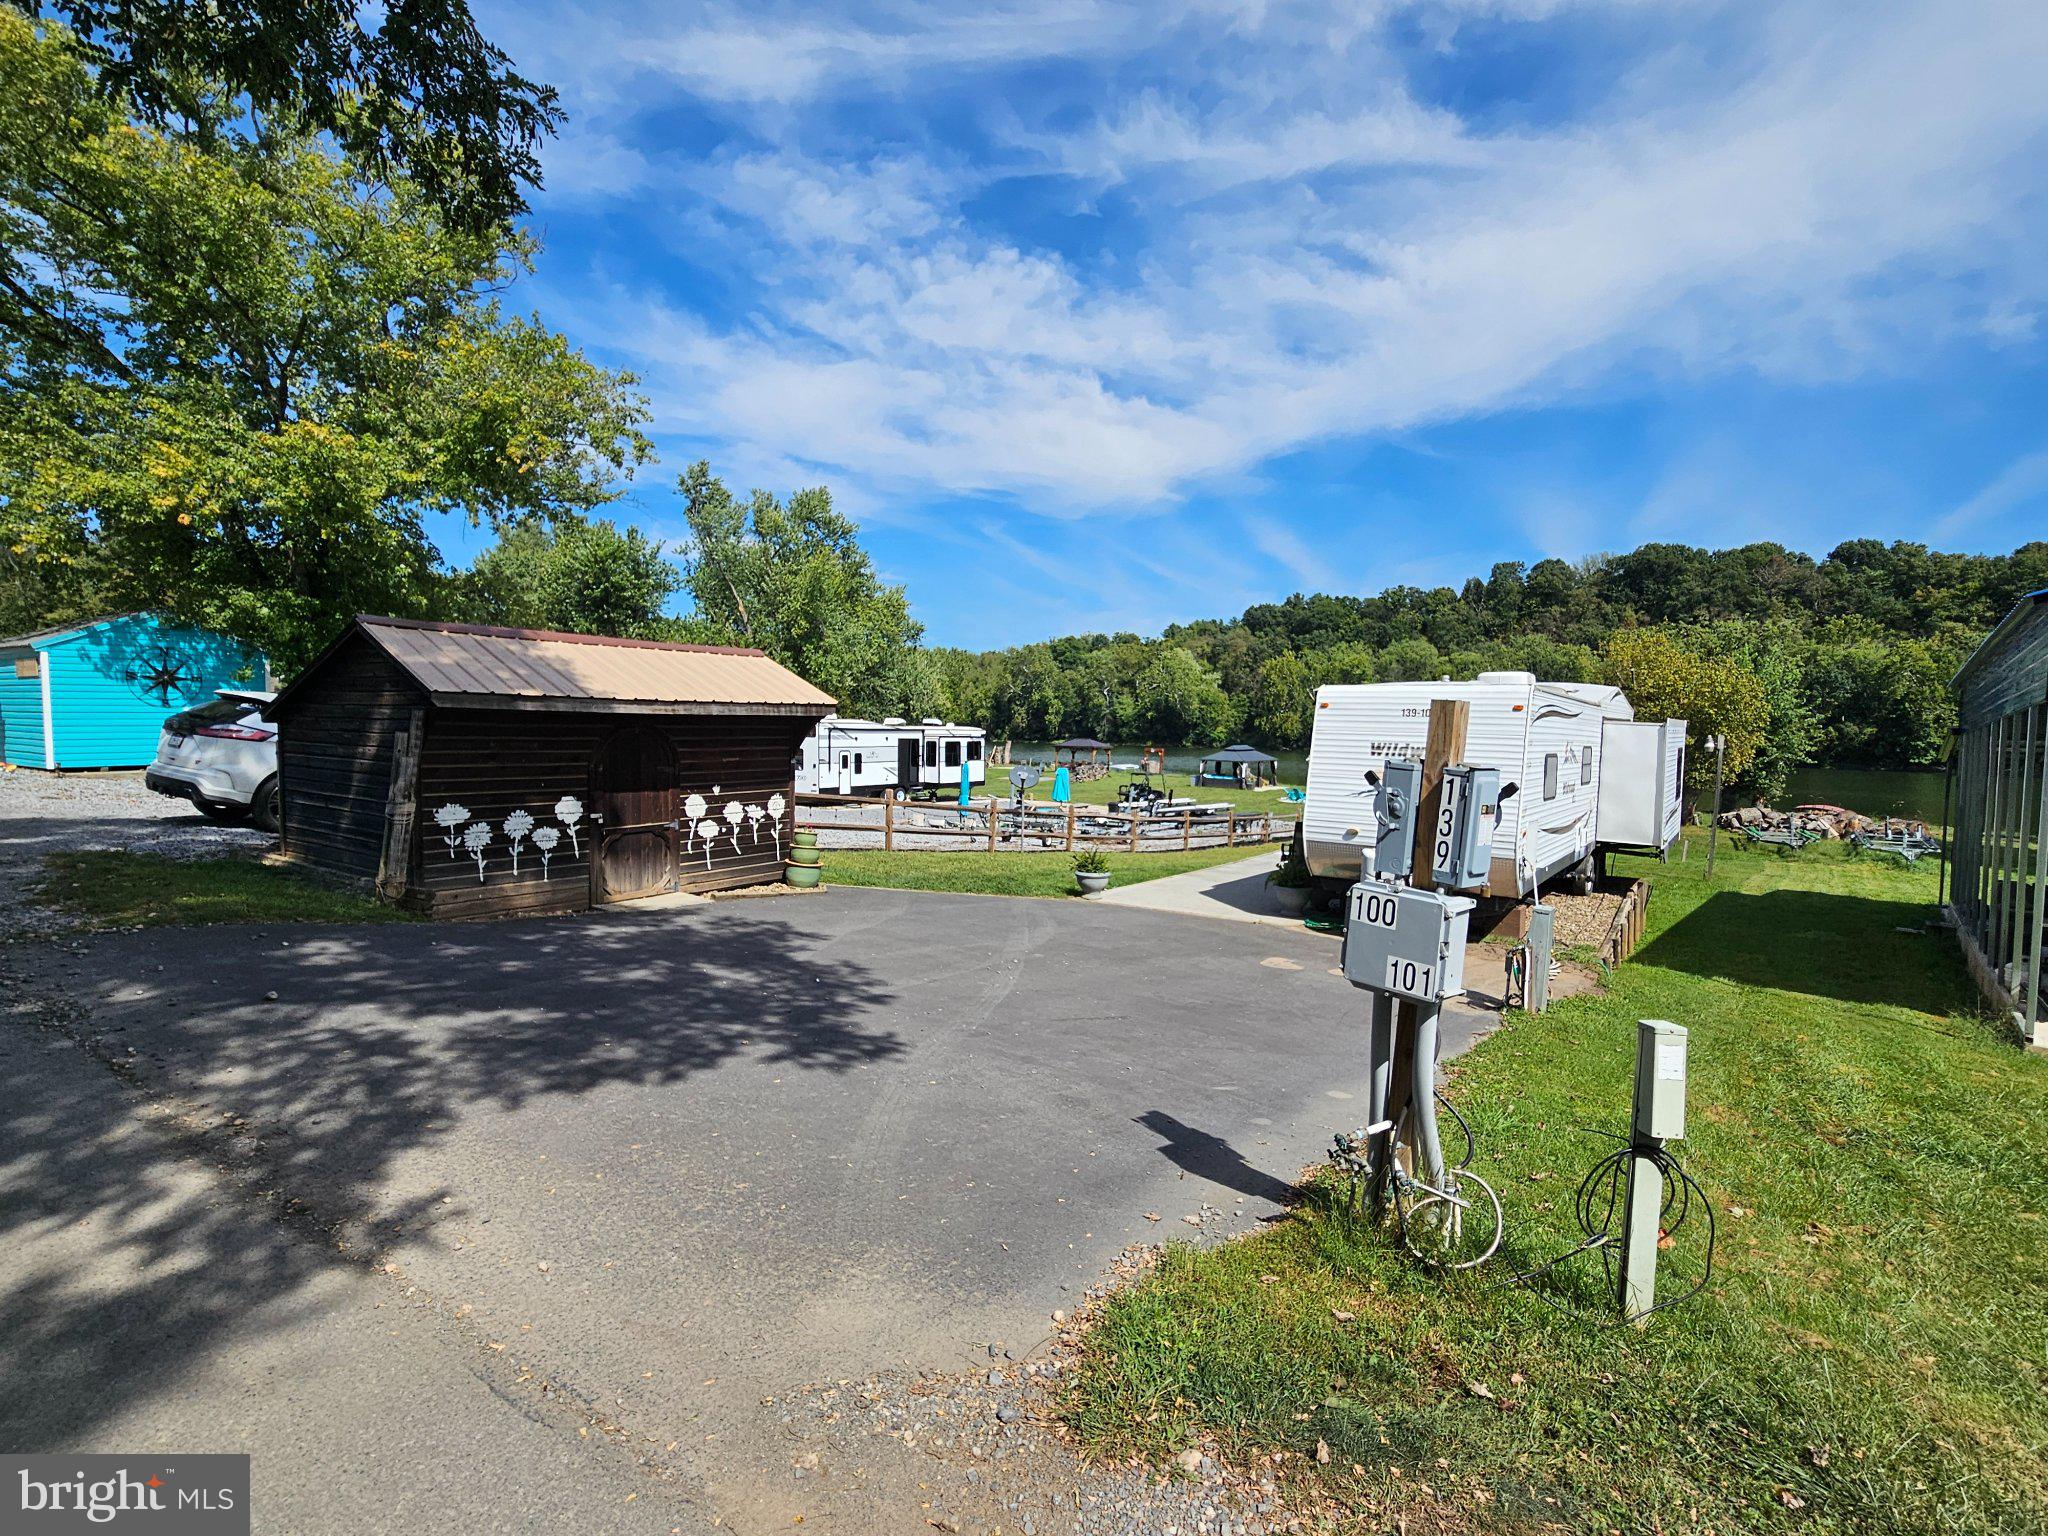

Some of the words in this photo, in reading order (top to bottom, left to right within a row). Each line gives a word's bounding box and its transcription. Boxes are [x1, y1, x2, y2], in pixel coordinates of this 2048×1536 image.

[1401, 708, 1431, 718] 139-10
[1371, 742, 1427, 758] Wildw
[1437, 777, 1455, 869] 139
[1356, 892, 1397, 927] 100
[1391, 959, 1431, 997] 101
